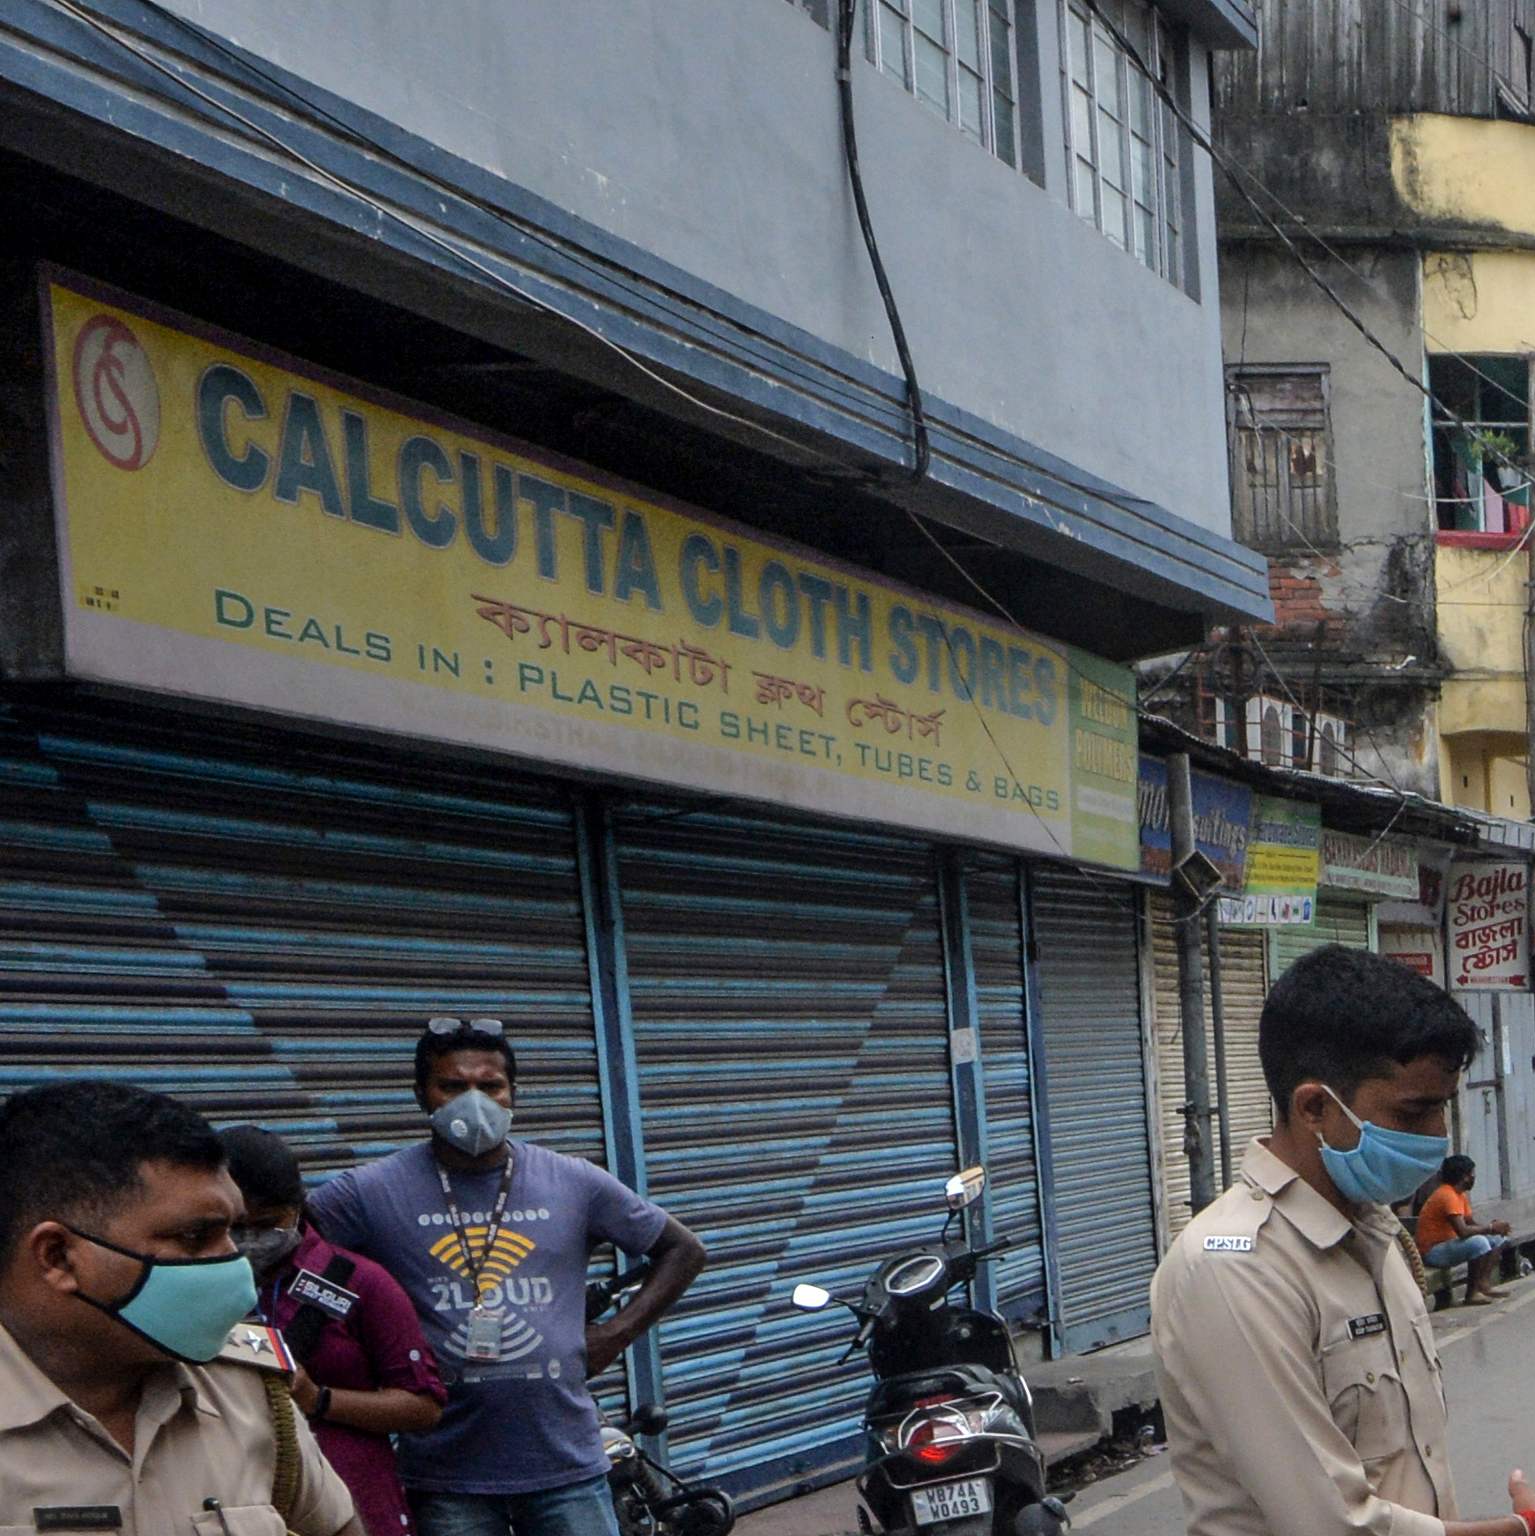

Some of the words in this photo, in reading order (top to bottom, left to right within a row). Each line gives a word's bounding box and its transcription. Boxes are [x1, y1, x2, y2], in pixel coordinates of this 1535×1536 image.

[195, 362, 664, 616] CALCUTTA
[680, 529, 873, 674] CLOTH
[888, 604, 1060, 728] STORES
[469, 591, 733, 695] ক্যালকাটা
[417, 643, 461, 678] IN
[517, 661, 700, 731] PLASTIC
[719, 710, 843, 767] SHEET,
[854, 741, 953, 788] TUBES
[966, 770, 982, 793] &
[993, 776, 1060, 811] BAGS
[1449, 865, 1527, 903] Bajla
[1453, 896, 1526, 926] Stores
[926, 1482, 977, 1505] WB74A
[930, 1497, 980, 1521] W0493
